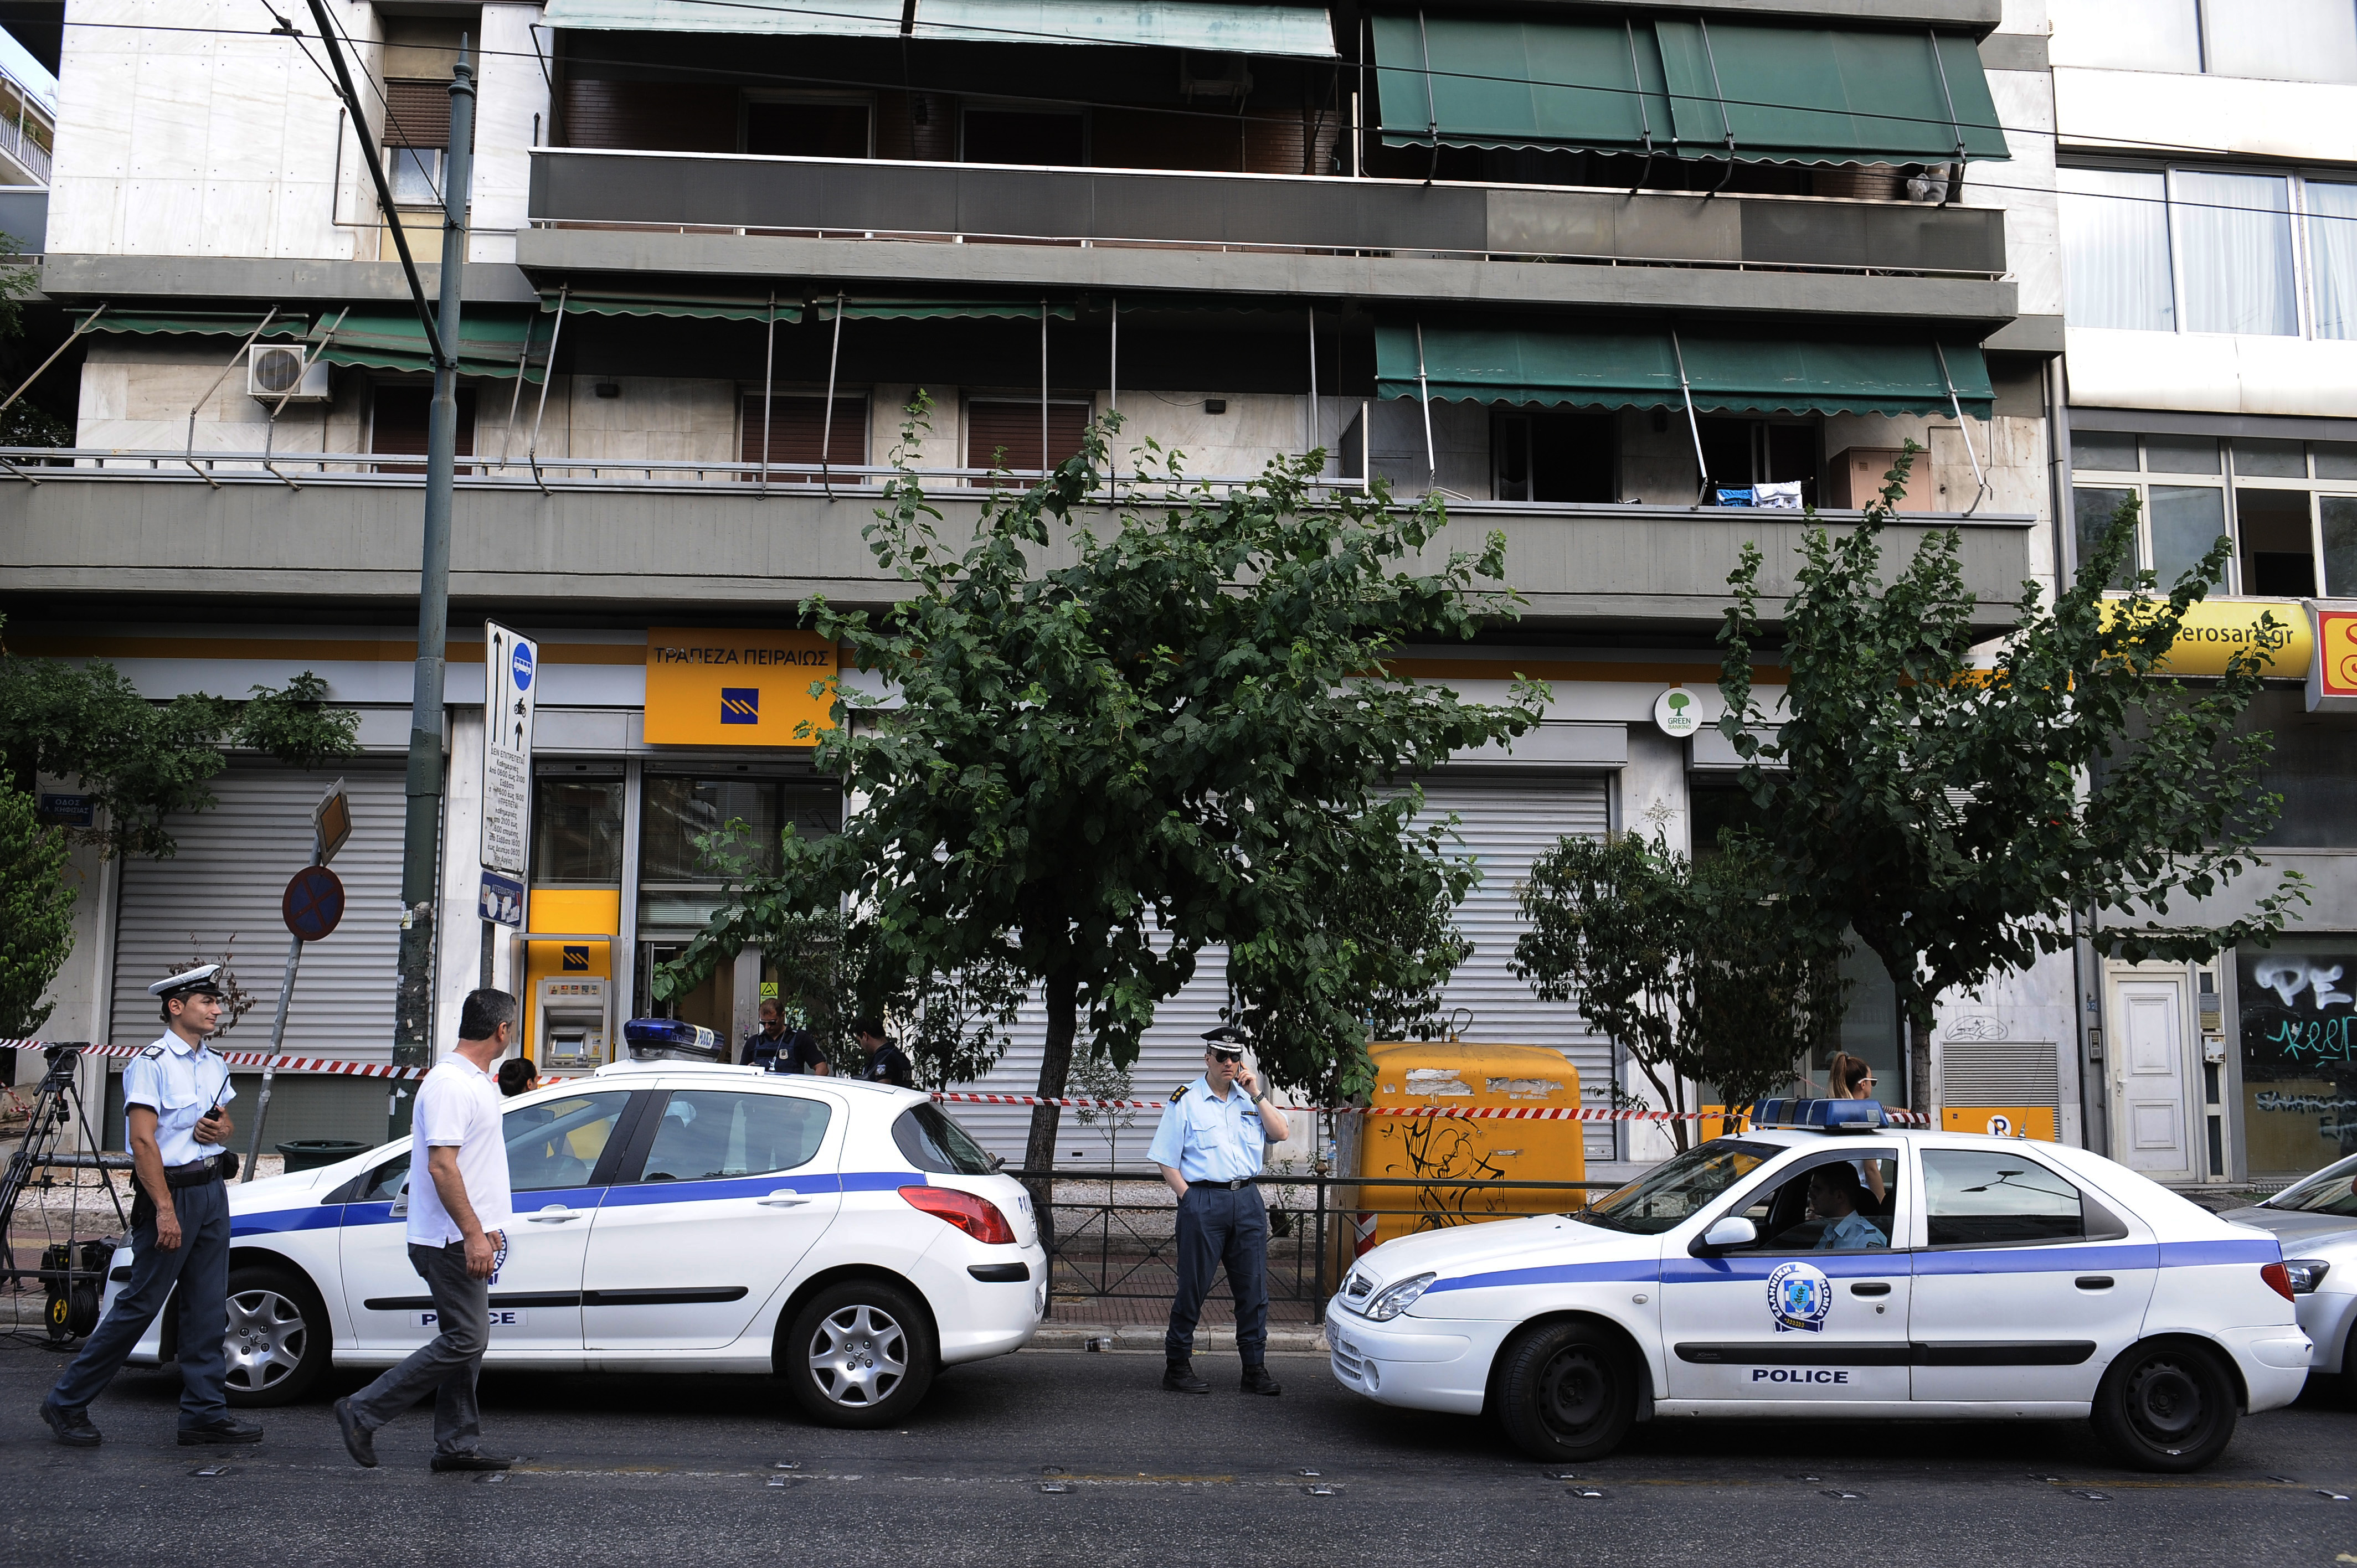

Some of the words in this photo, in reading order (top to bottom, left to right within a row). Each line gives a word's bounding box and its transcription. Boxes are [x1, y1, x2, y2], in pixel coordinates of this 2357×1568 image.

[653, 647, 739, 664] ΤΡΑΠΕΖΑ
[744, 649, 829, 666] ΠΕΙΡΑΙΩΣ
[1768, 1265, 1792, 1318] ΕΛΛΗΝΙΚΗ
[421, 1312, 516, 1325] PCE
[1752, 1369, 1849, 1384] POLICE
